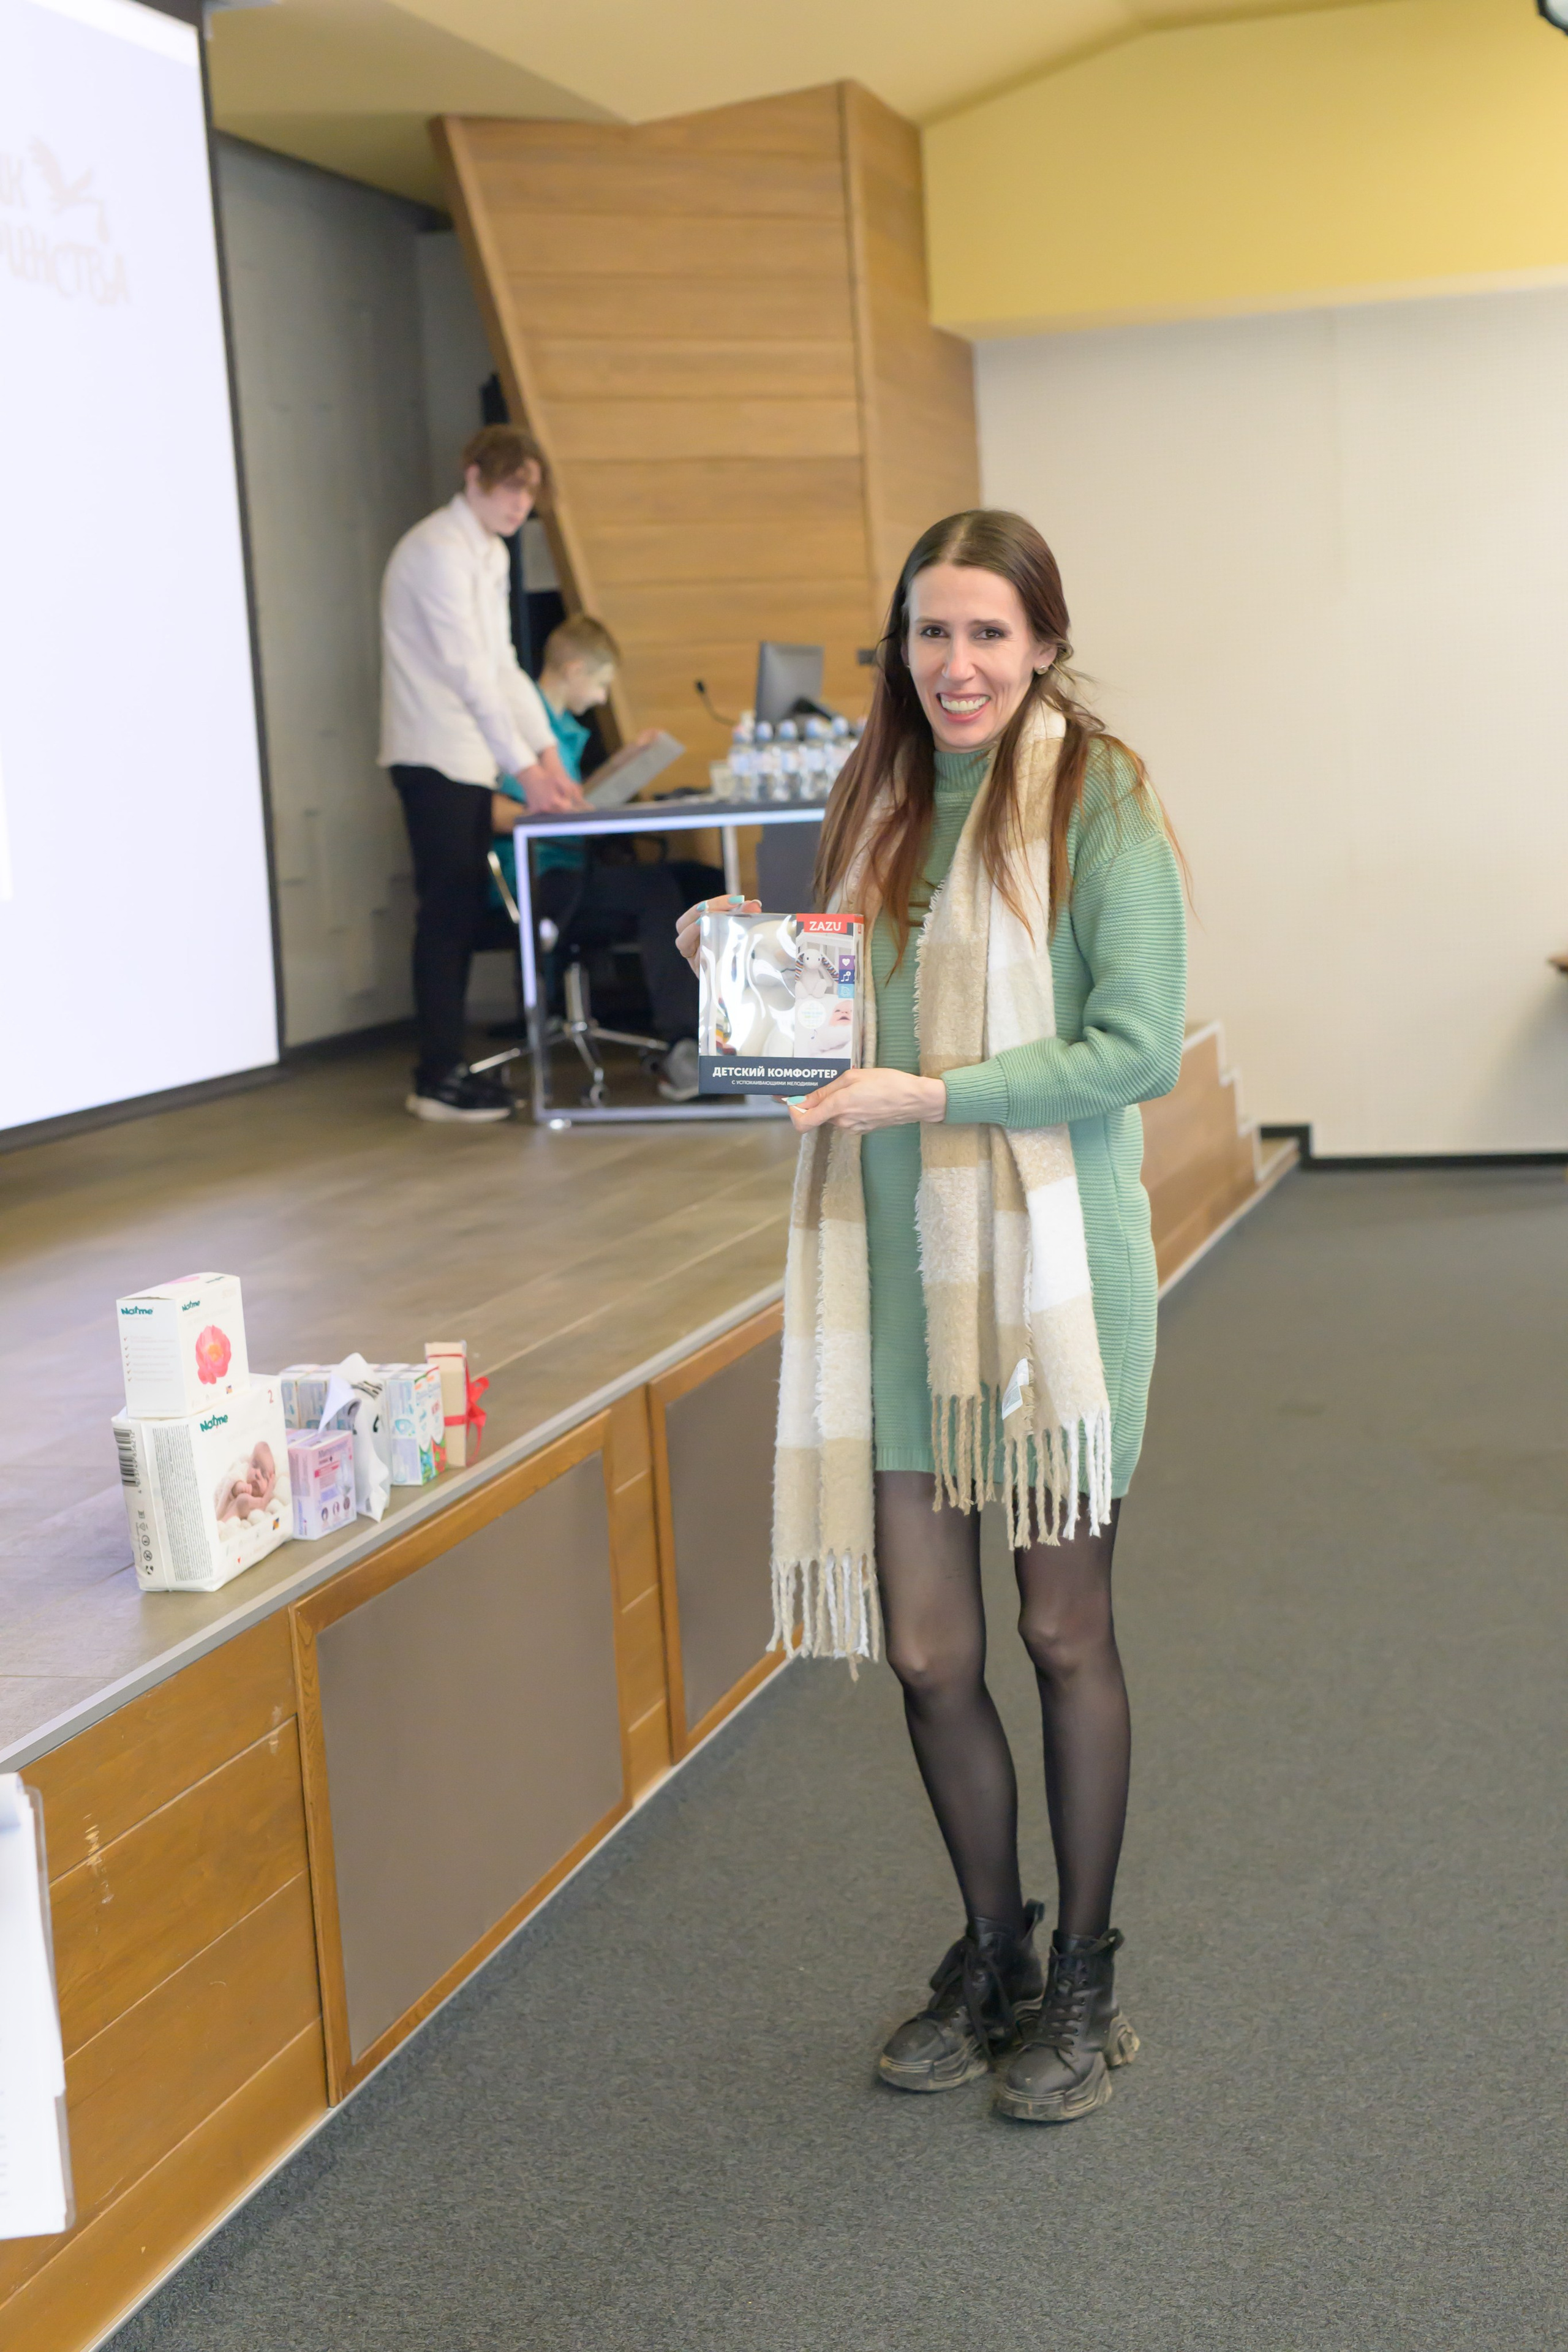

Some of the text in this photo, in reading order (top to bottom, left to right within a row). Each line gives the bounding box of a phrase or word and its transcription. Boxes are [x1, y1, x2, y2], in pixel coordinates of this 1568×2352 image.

[809, 921, 842, 931] ZAZU
[712, 1066, 838, 1079] ДЕТСКИЙ КОМФОРТЕР
[268, 1390, 274, 1403] 2
